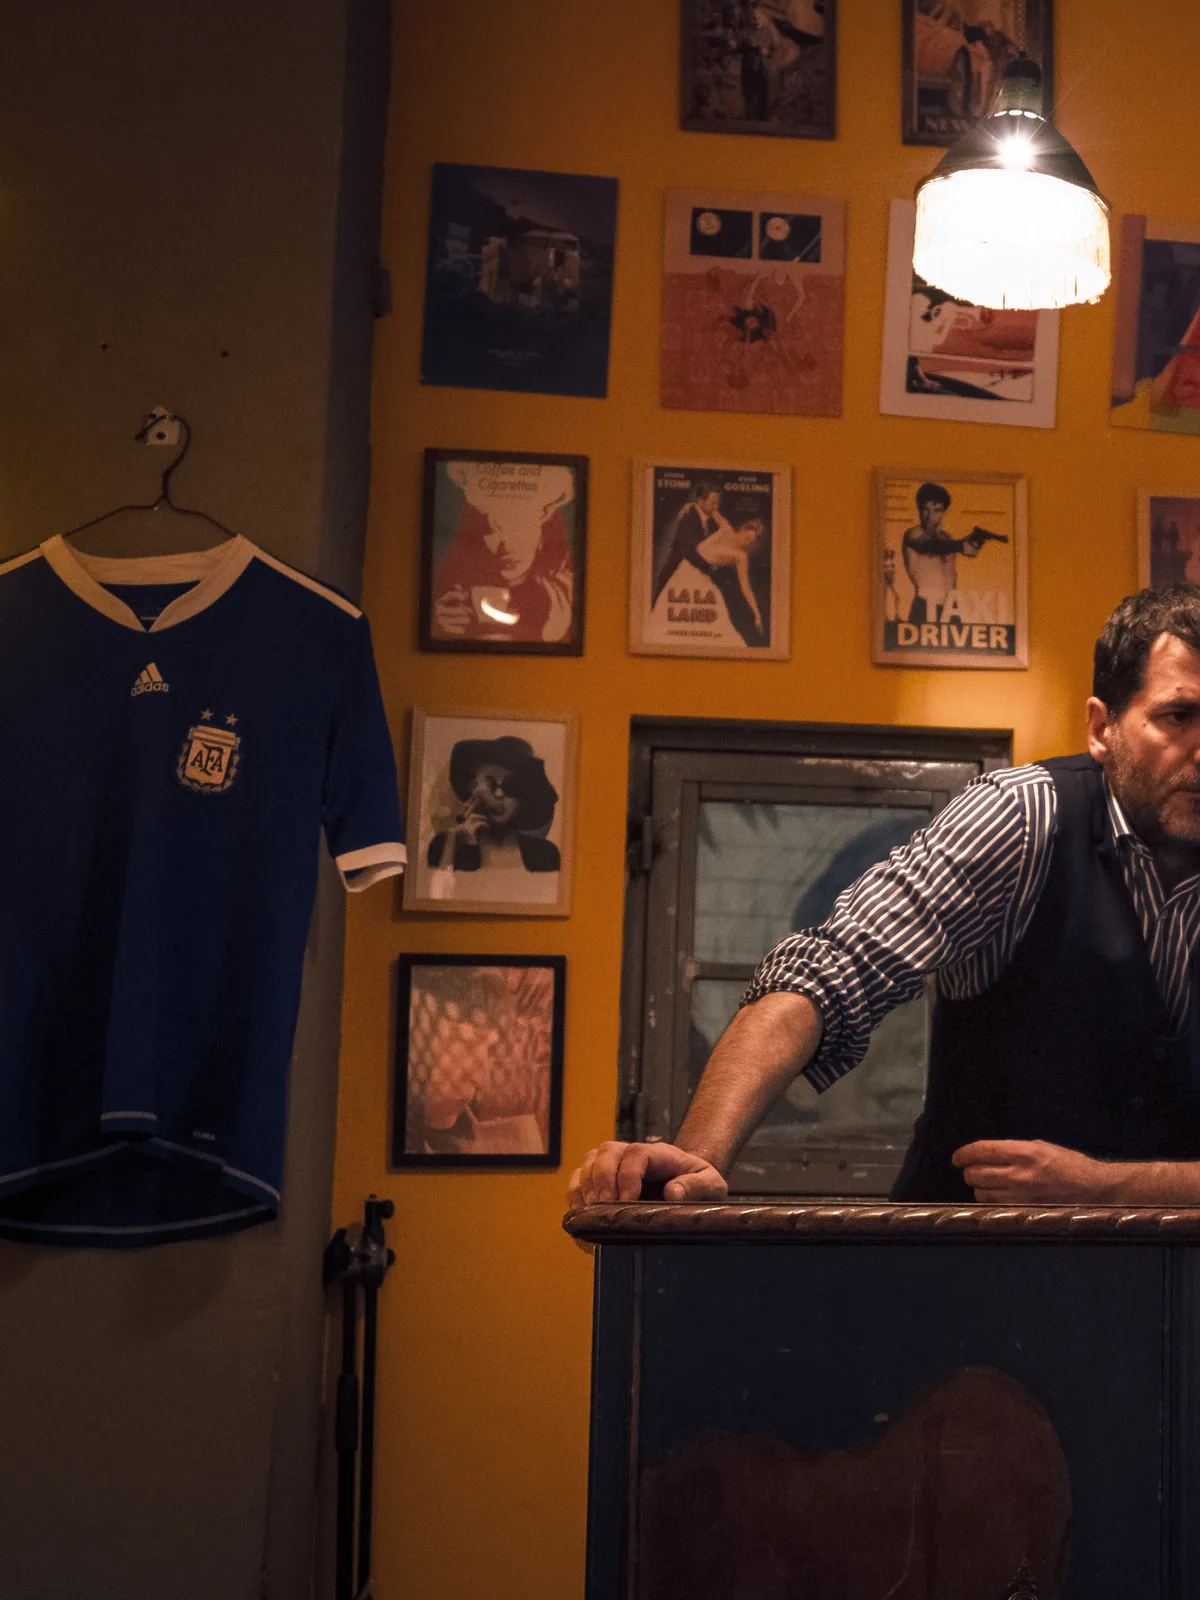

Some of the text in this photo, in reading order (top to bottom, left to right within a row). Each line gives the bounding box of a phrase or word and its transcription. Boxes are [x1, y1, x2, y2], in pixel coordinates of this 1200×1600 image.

[657, 479, 691, 489] STONE
[723, 482, 770, 493] GOSLING
[667, 588, 717, 605] LA LA
[920, 588, 1009, 624] TAXI
[667, 607, 718, 623] LAND
[897, 622, 1009, 649] DRIVER
[131, 682, 169, 697] adidas
[190, 742, 224, 777] AFA
